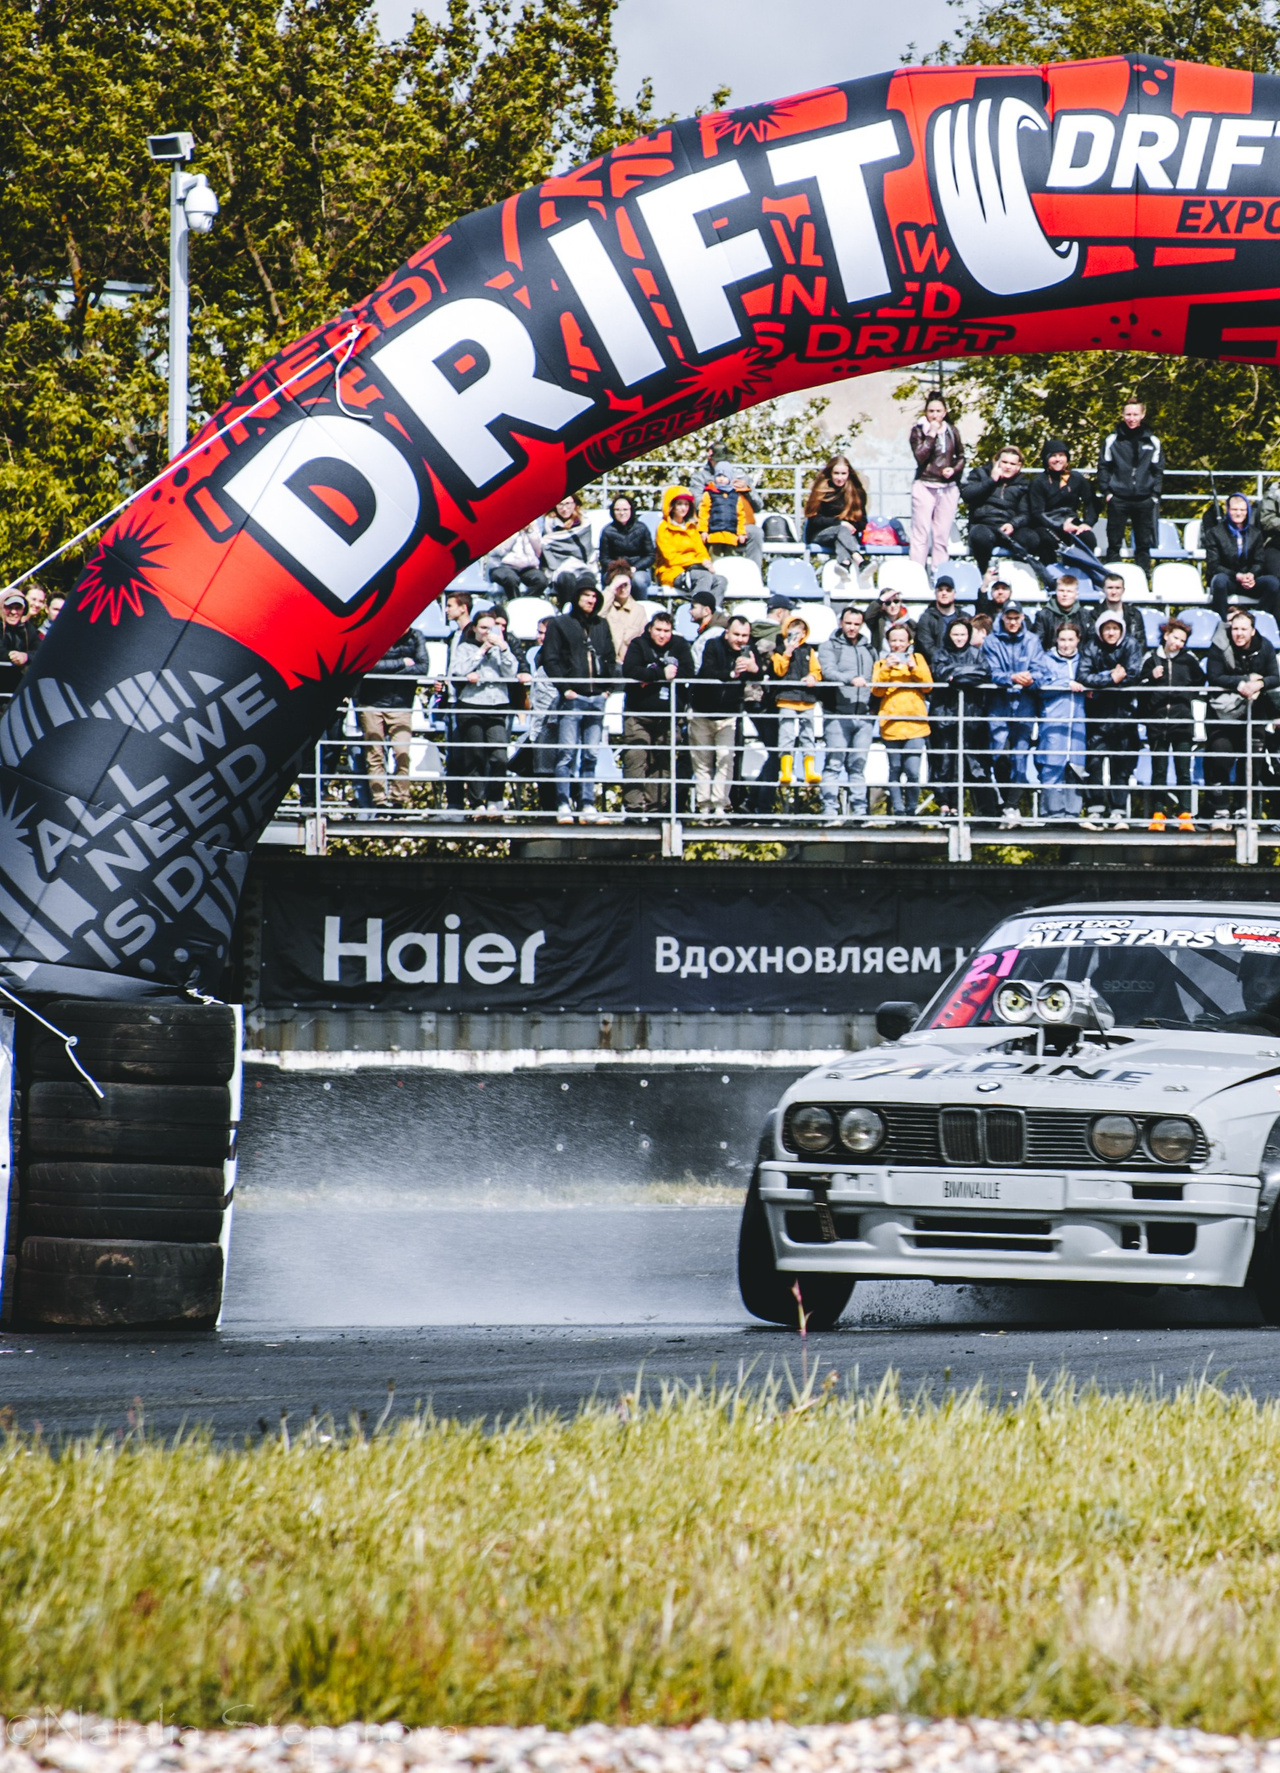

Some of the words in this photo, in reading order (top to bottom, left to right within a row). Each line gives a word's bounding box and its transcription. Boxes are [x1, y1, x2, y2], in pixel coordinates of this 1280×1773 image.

[222, 117, 903, 606] DRIFT
[804, 323, 1008, 357] DRIFT
[36, 763, 170, 874] ALL
[158, 672, 278, 765] WE
[84, 743, 267, 892] NEED
[82, 898, 156, 969] IS
[323, 914, 546, 986] Haier
[655, 936, 943, 980] Вдохновляем
[1014, 929, 1086, 950] ALL
[1093, 929, 1217, 949] STARS
[964, 949, 1020, 983] 21
[1102, 980, 1155, 993] sparco
